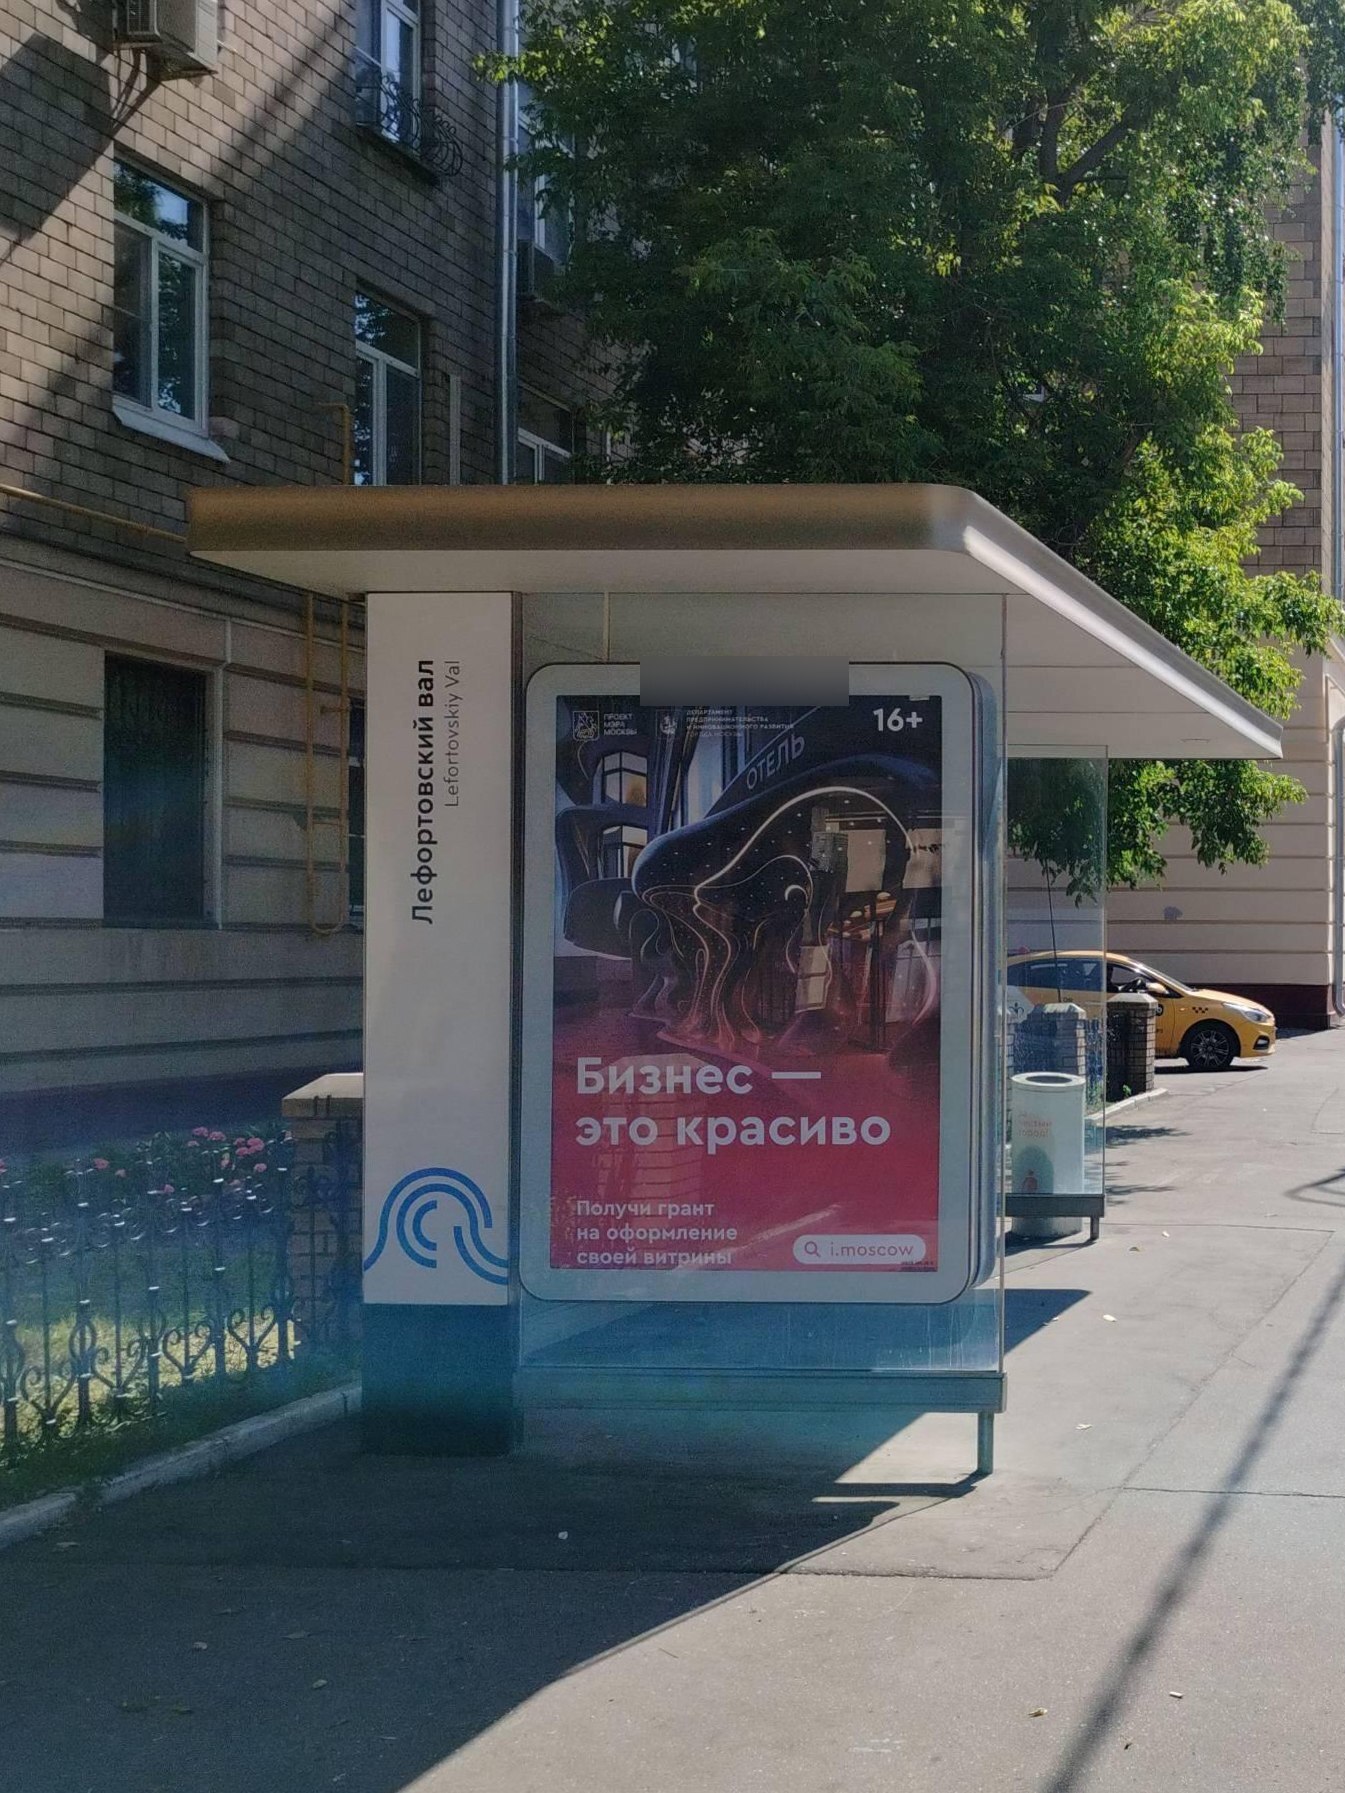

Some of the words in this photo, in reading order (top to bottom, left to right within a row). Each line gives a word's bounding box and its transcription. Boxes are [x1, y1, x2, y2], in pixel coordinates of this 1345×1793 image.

[418, 660, 434, 707] вал
[444, 660, 461, 688] Val
[872, 707, 923, 732] 16+
[443, 693, 463, 808] Lefortovskiy
[746, 733, 806, 790] ОТЕЛЬ
[410, 716, 438, 925] Лефортовский
[576, 1056, 753, 1095] Бизнес
[575, 1116, 659, 1146] это
[676, 1115, 892, 1155] красиво
[577, 1201, 651, 1219] Получи
[658, 1203, 715, 1219] грант
[577, 1227, 600, 1241] на
[606, 1222, 738, 1243] оформление
[830, 1241, 914, 1257] i.moscow
[576, 1246, 637, 1264] своей
[644, 1251, 732, 1266] витрины
